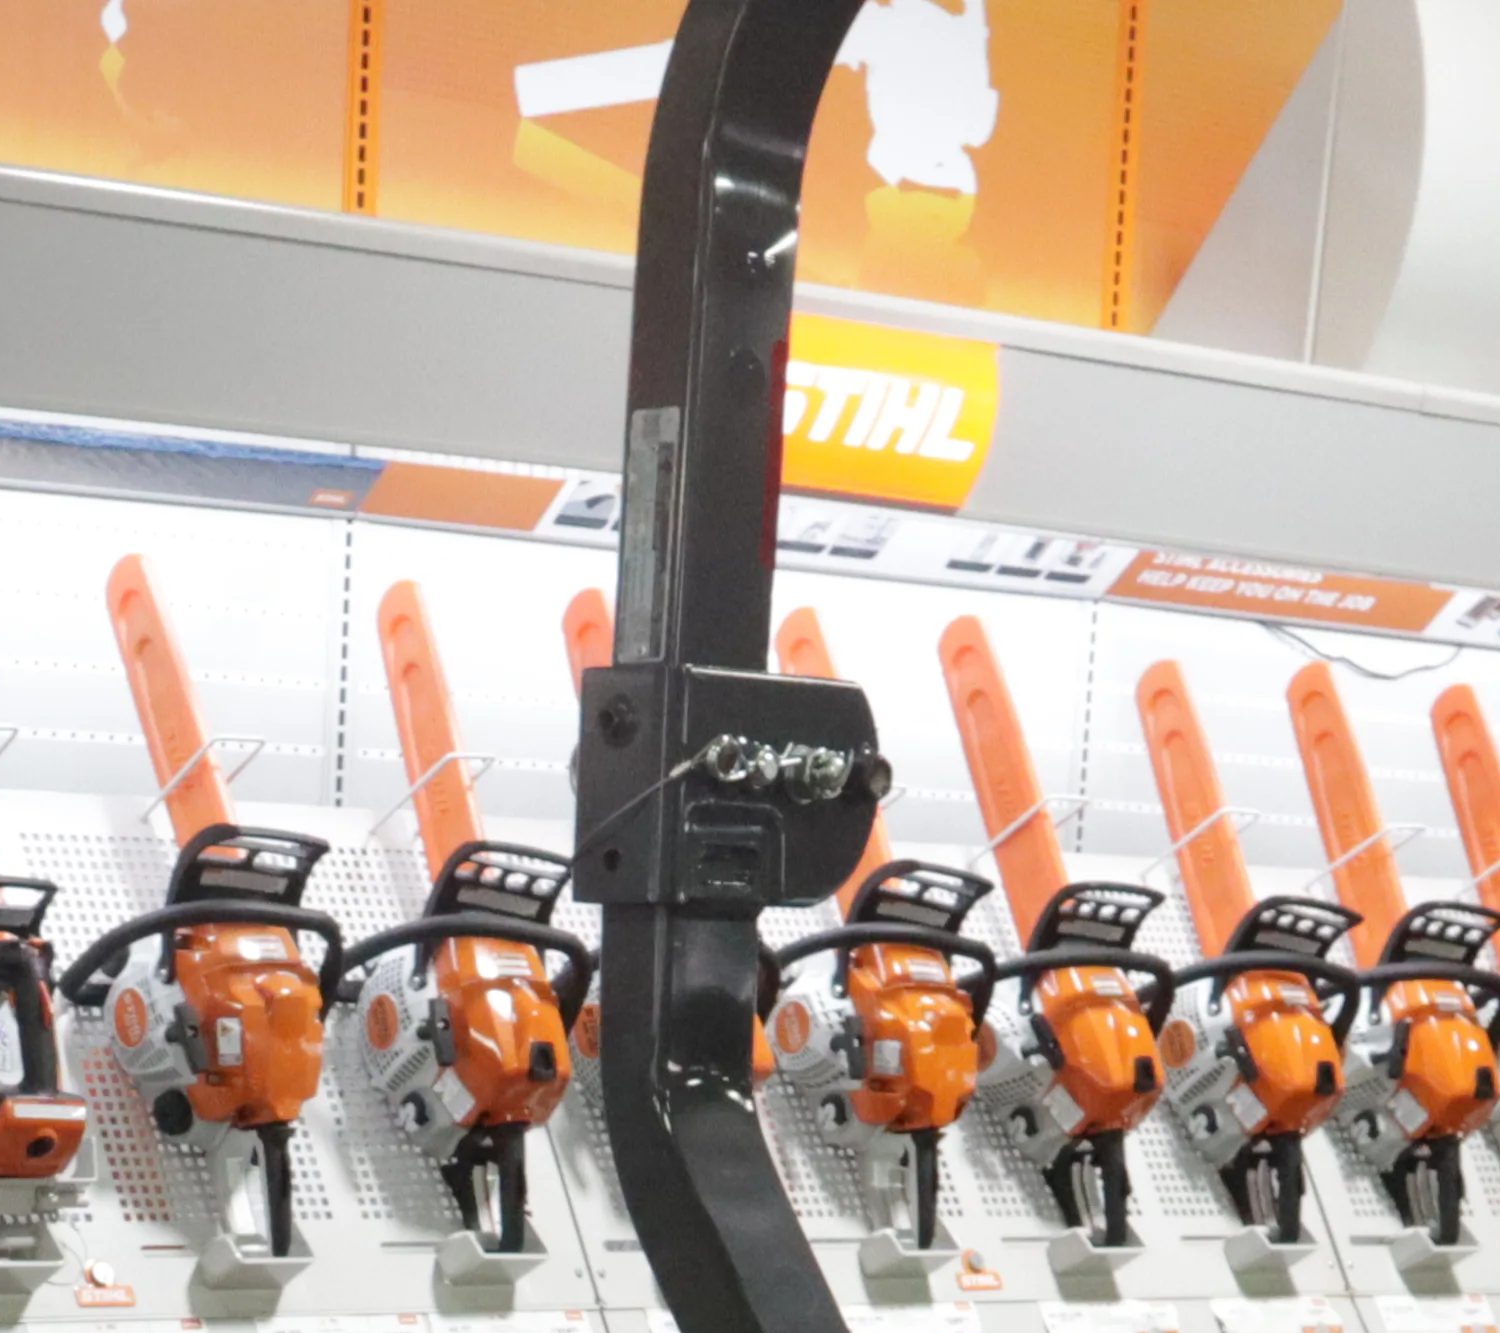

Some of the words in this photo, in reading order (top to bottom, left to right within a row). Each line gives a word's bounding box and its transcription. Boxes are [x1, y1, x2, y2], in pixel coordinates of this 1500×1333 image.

[1136, 570, 1187, 588] HELP
[1187, 576, 1234, 593] KEEP
[1236, 580, 1269, 597] YOU
[1273, 586, 1301, 601] ON
[1303, 588, 1336, 605] THE
[1338, 593, 1376, 611] JOB
